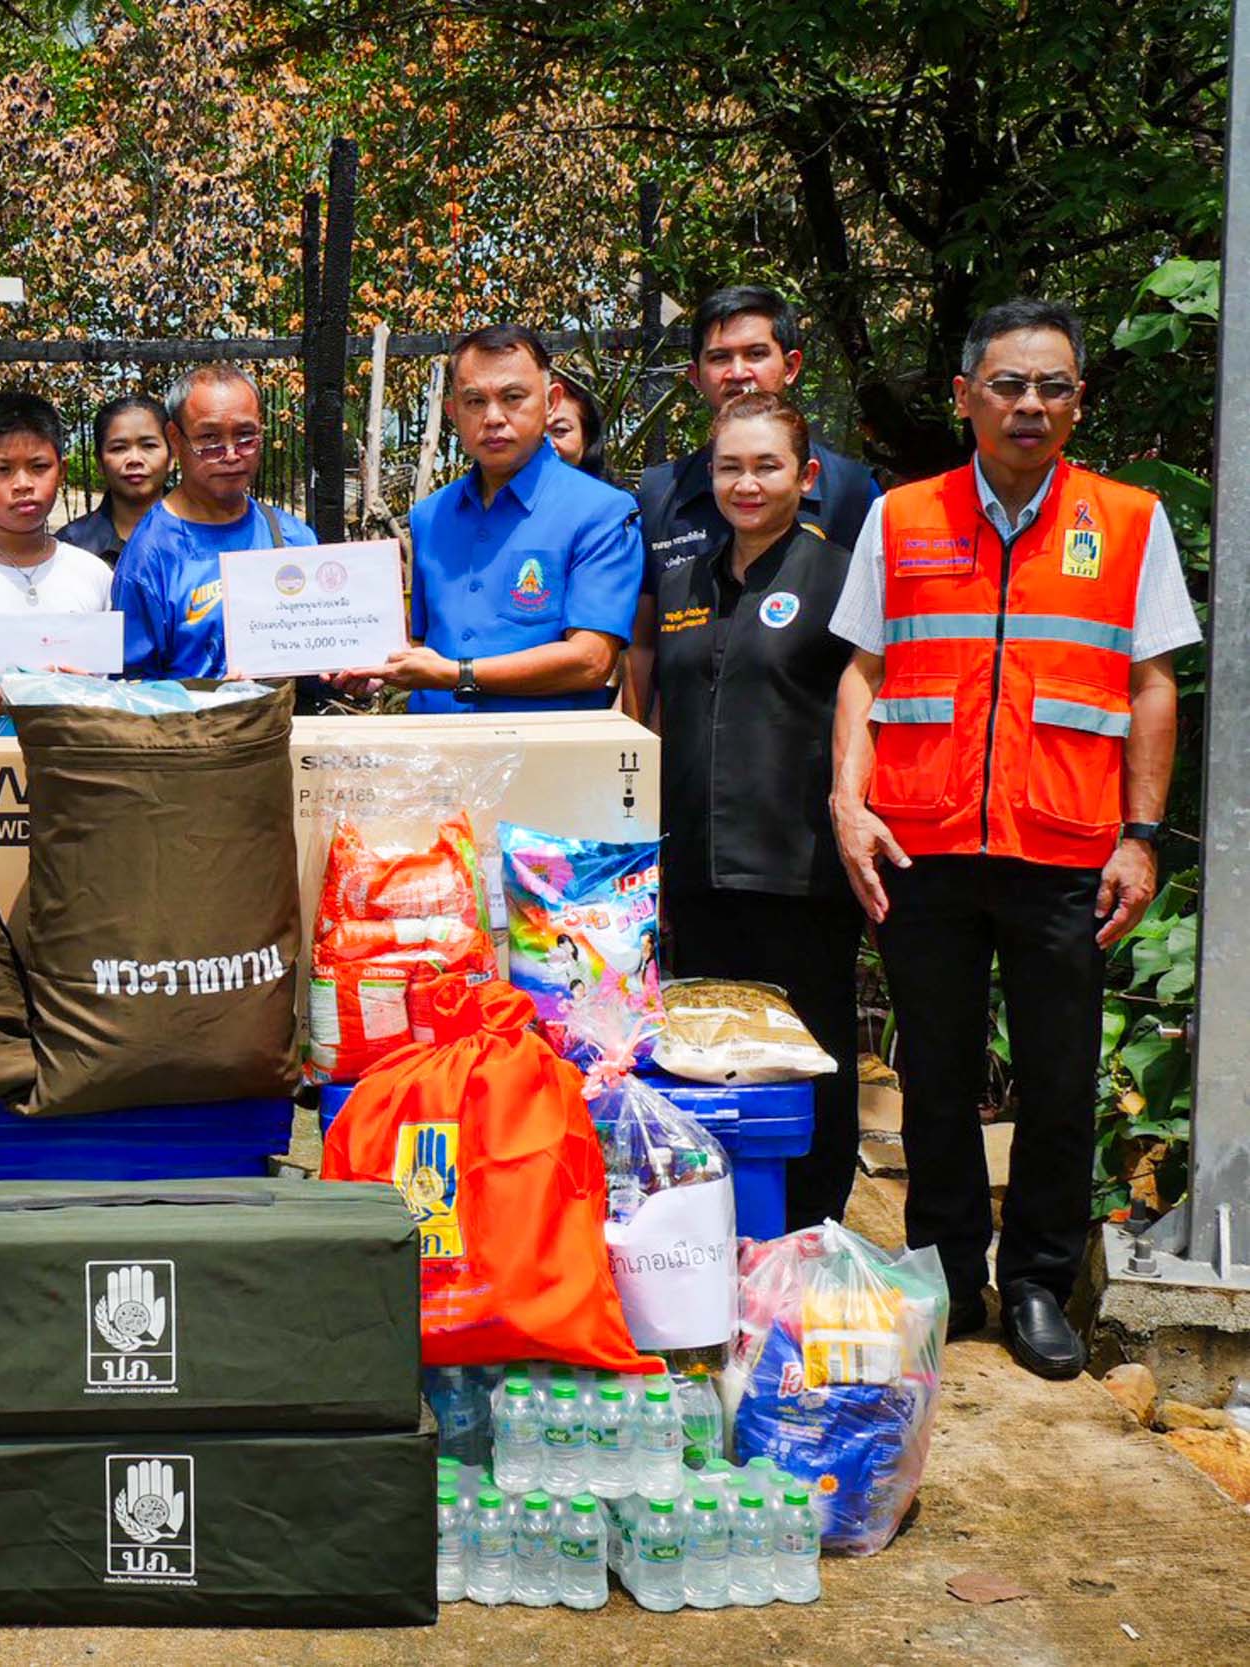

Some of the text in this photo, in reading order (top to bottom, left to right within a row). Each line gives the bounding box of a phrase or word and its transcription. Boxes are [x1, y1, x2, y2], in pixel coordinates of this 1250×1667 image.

[304, 637, 337, 650] 3,000
[92, 944, 285, 995] พระราชทาน
[102, 1356, 158, 1381] ปภ.
[122, 1547, 177, 1573] ปภ.
